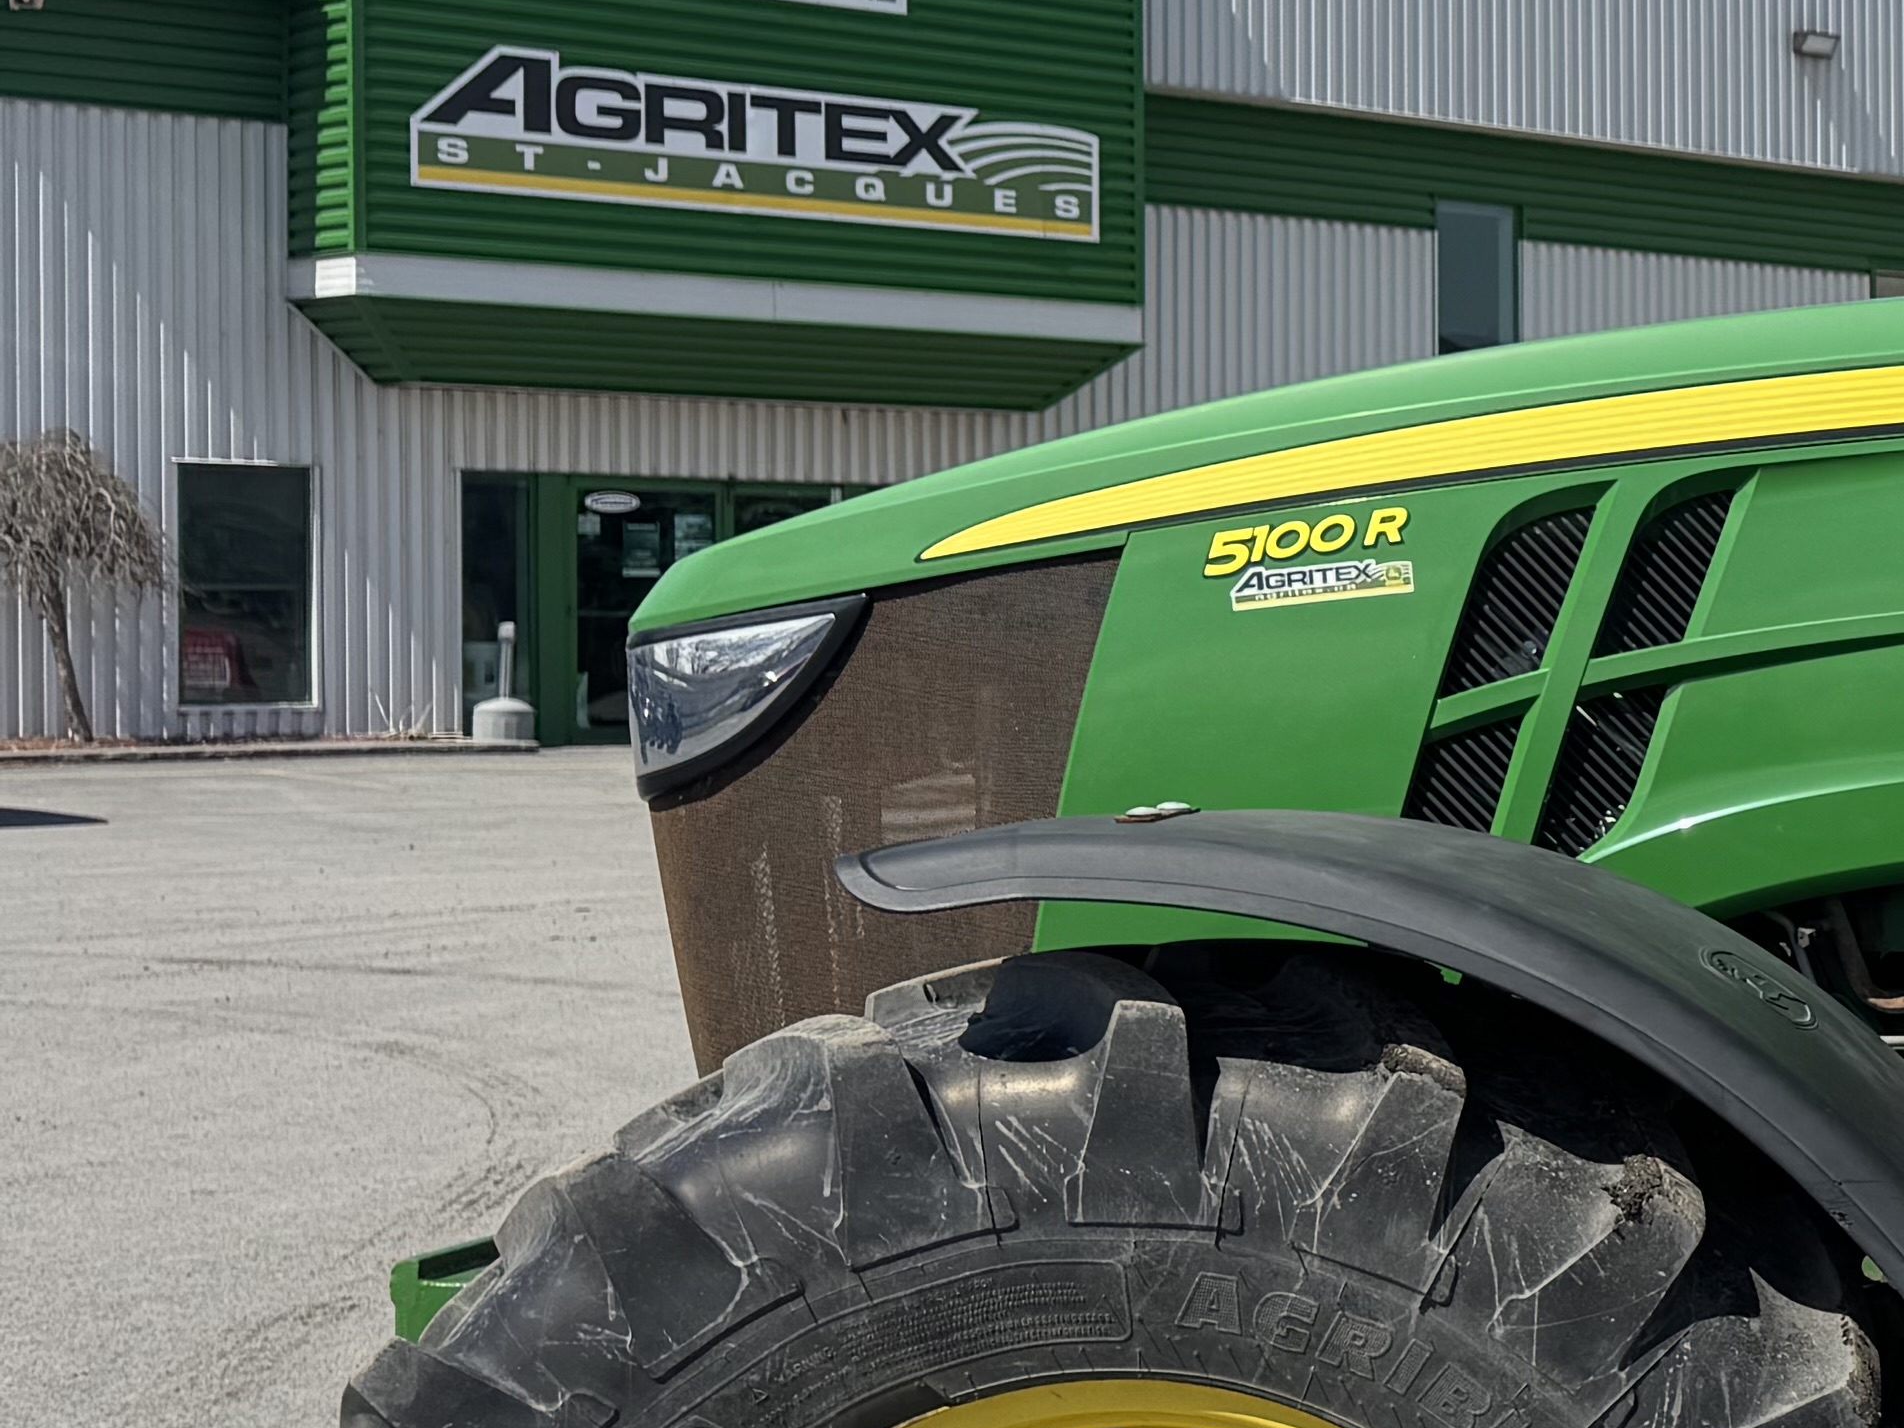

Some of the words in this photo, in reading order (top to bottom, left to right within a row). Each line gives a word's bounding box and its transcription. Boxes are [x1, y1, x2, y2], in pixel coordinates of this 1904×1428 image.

[423, 54, 973, 174] AGRITEX
[437, 139, 1079, 219] ST-JACQUES
[1236, 562, 1373, 592] AGRITEX
